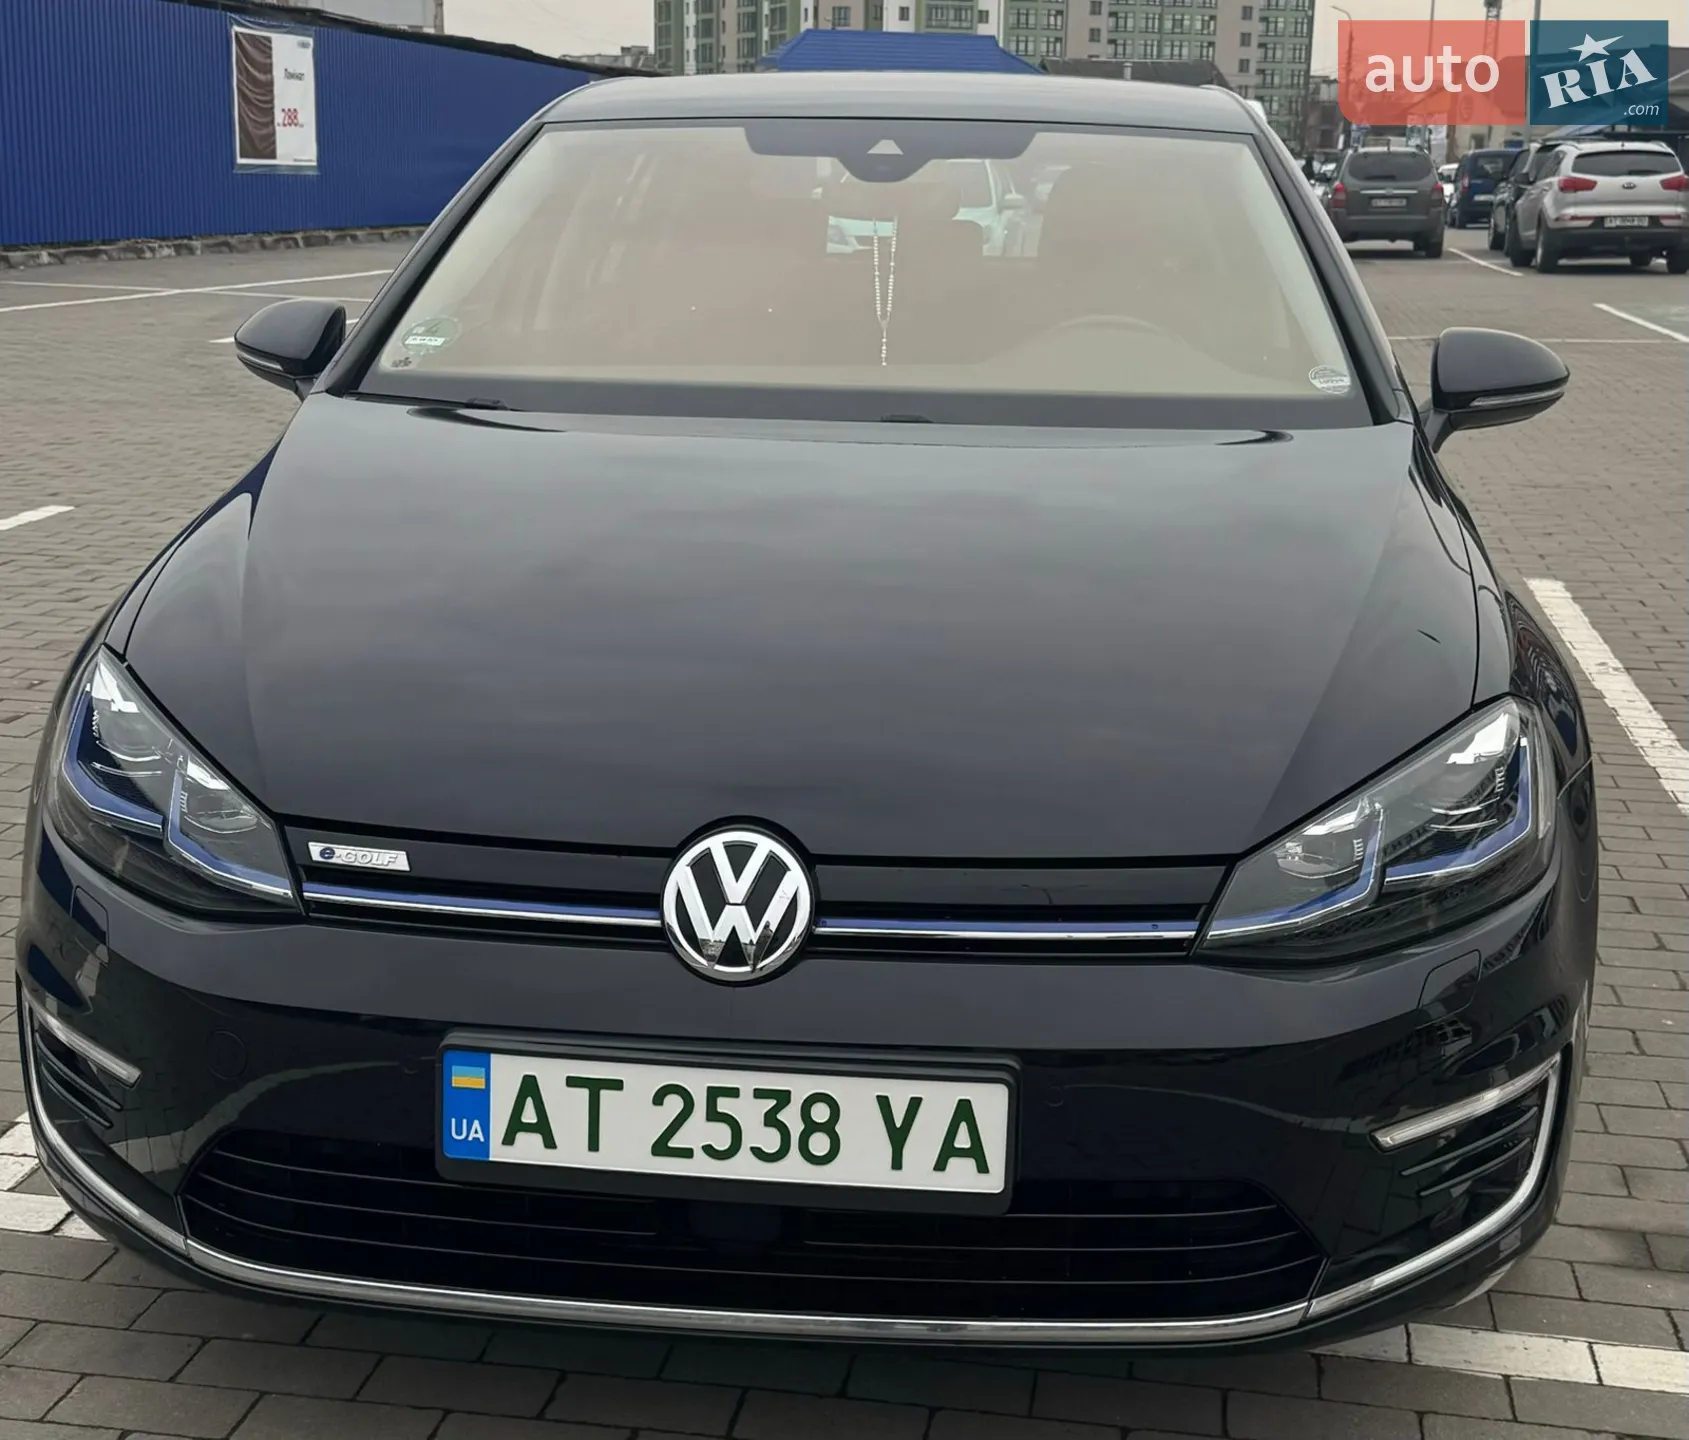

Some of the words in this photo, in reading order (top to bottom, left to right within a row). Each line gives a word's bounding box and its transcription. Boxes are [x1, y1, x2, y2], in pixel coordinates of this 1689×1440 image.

[281, 108, 299, 127] 288
[450, 1117, 485, 1142] UA
[501, 1074, 624, 1153] AT
[650, 1083, 841, 1166] 2538
[875, 1094, 990, 1174] YA
